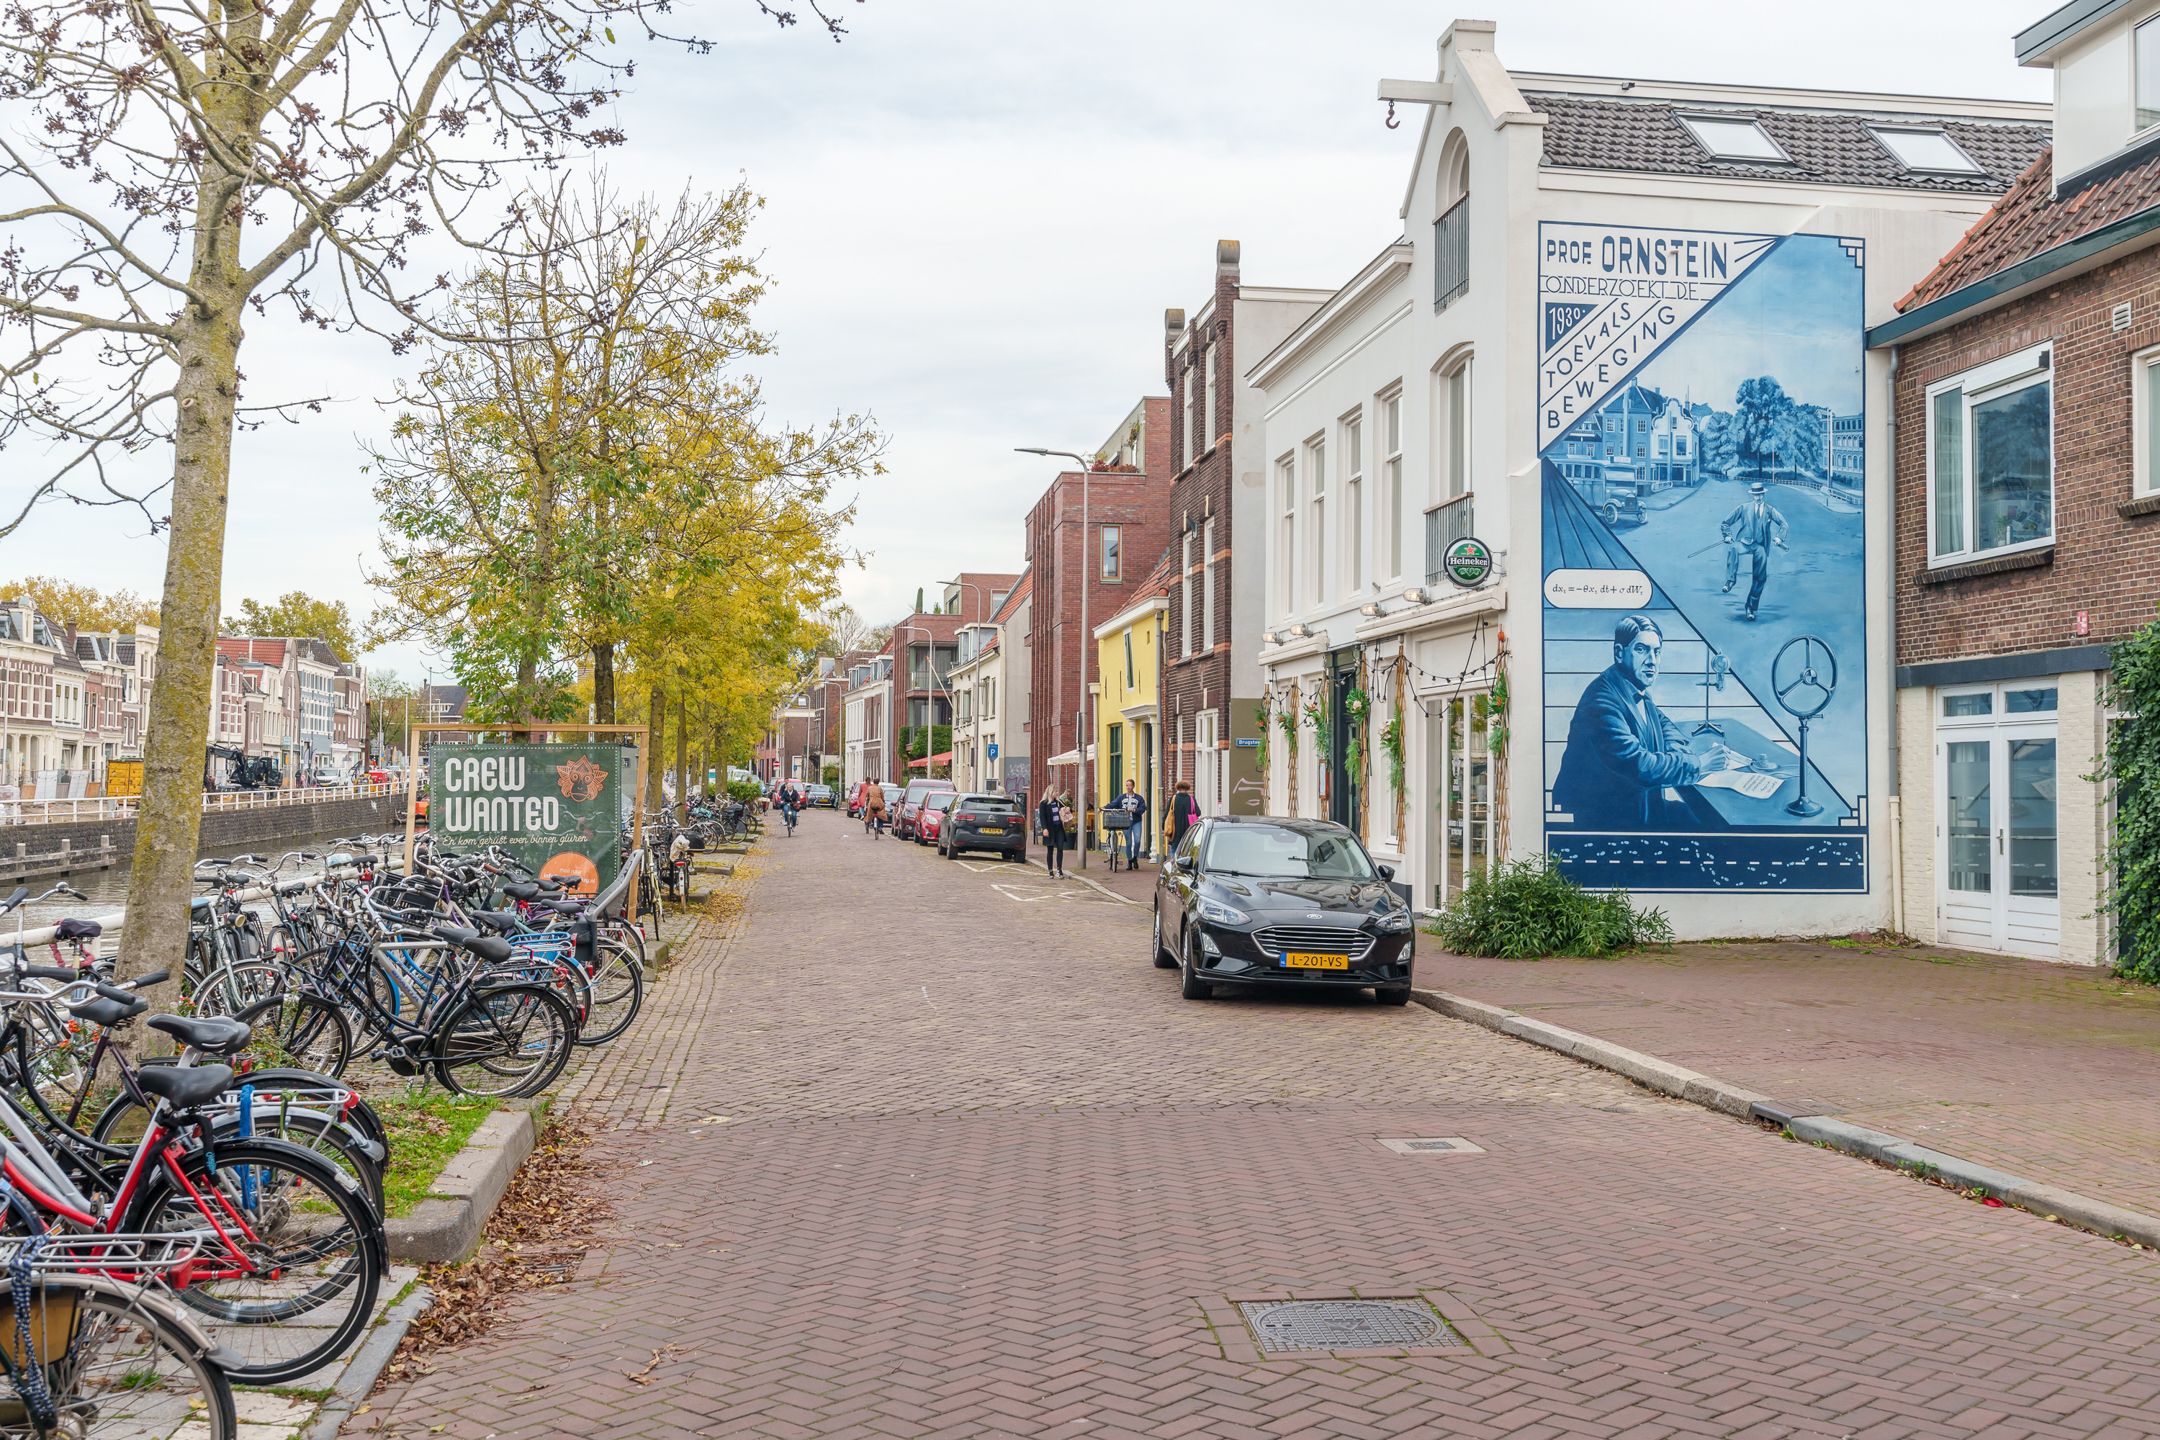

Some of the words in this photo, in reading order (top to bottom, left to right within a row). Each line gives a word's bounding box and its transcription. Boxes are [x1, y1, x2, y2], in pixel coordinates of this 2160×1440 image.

[1547, 239, 1592, 265] PROF.
[1602, 235, 1727, 279] ORNSTEIN
[1546, 275, 1667, 299] ONDERZOEKT
[1677, 282, 1698, 300] DE
[1545, 302, 1631, 388] TOEVALS
[1548, 305, 1675, 429] BEWEGING
[1449, 557, 1488, 566] Heineken
[445, 757, 525, 792] CREW
[445, 797, 559, 832] WANTED
[442, 836, 457, 846] En
[458, 836, 478, 846] kom
[530, 835, 558, 844] binnen
[559, 835, 588, 846] gluren
[1292, 955, 1342, 967] L-201-VS
